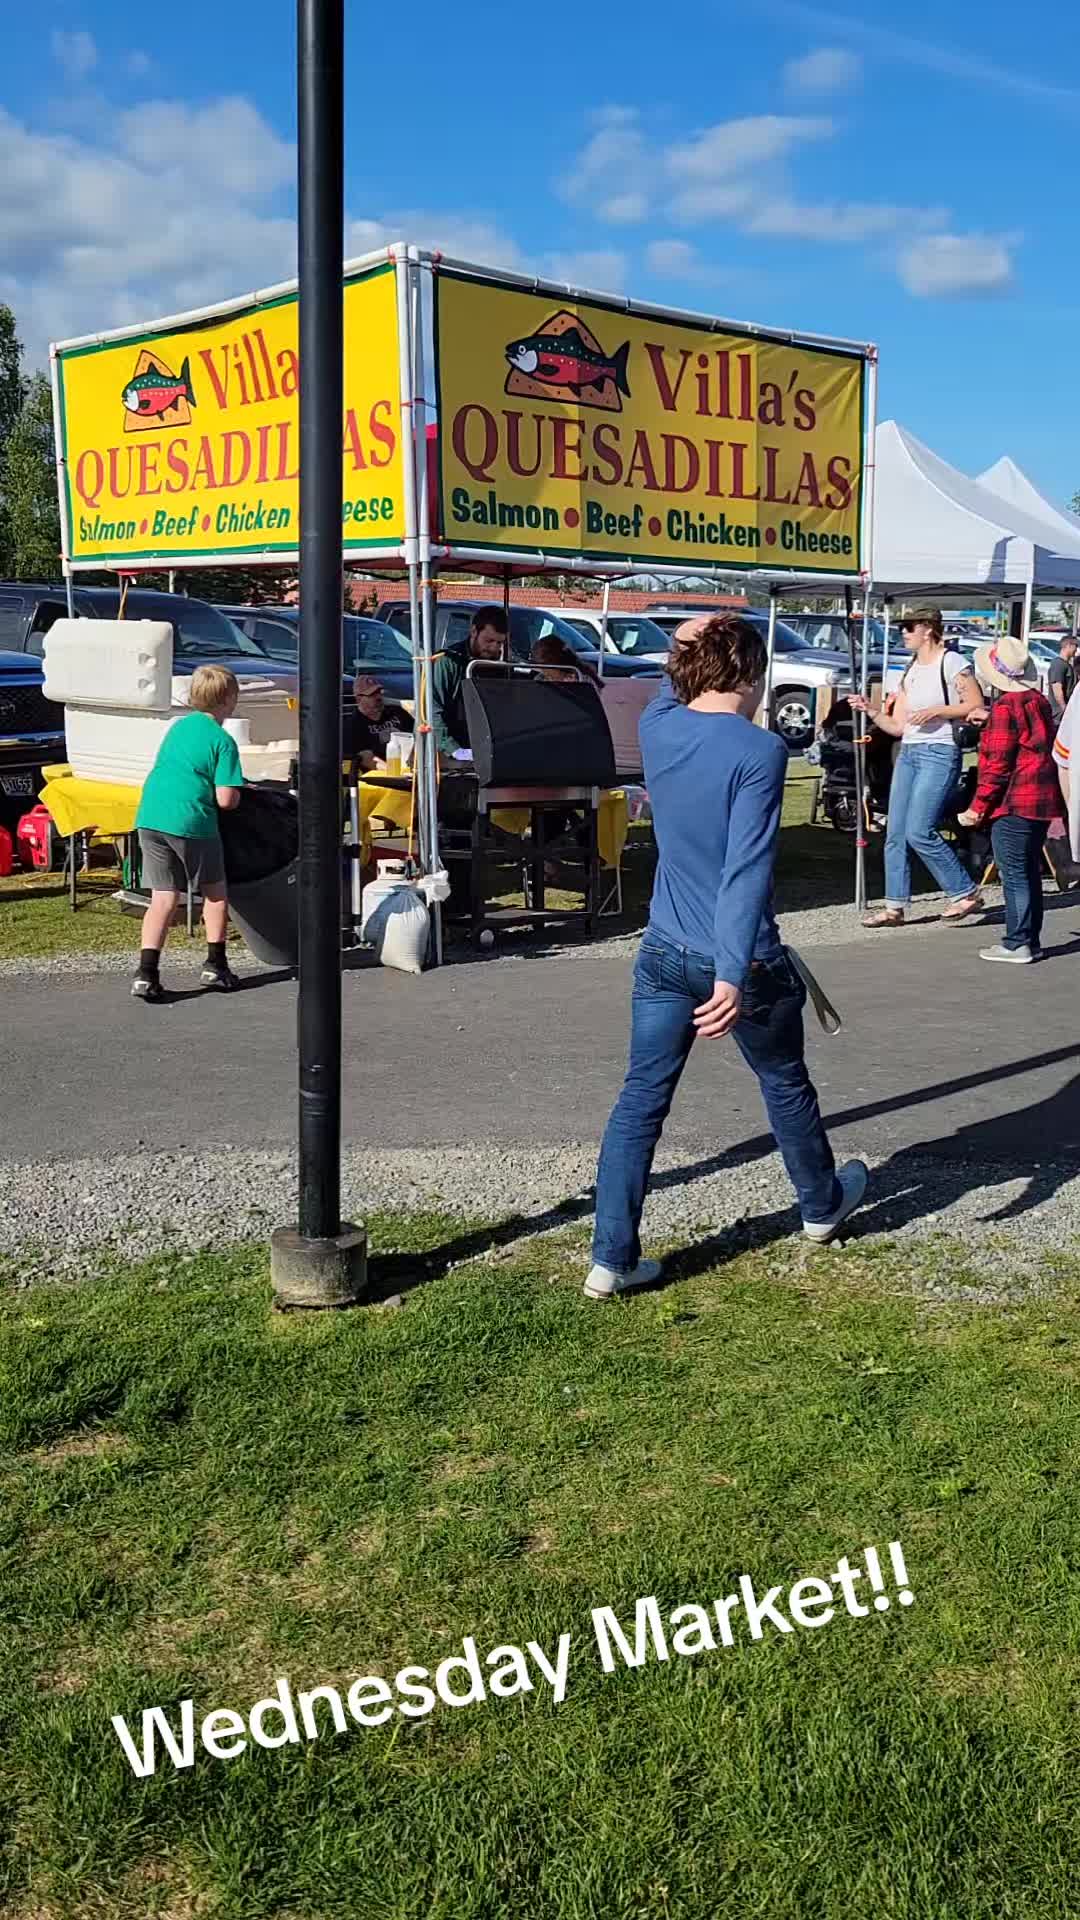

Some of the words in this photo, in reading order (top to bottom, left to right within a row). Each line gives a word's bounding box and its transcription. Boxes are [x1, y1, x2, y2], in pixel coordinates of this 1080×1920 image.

[198, 328, 298, 410] Villa
[643, 342, 817, 432] Villa's
[76, 399, 396, 508] QUESADILAS
[452, 403, 851, 511] QUESADILLAS
[79, 514, 136, 542] Salmon
[151, 505, 200, 537] Beef
[215, 499, 292, 534] Chicken
[342, 496, 394, 524] eese
[452, 487, 559, 531] Salmon
[586, 501, 644, 538] Beef
[667, 508, 760, 548] Chicken
[780, 519, 852, 556] Cheese
